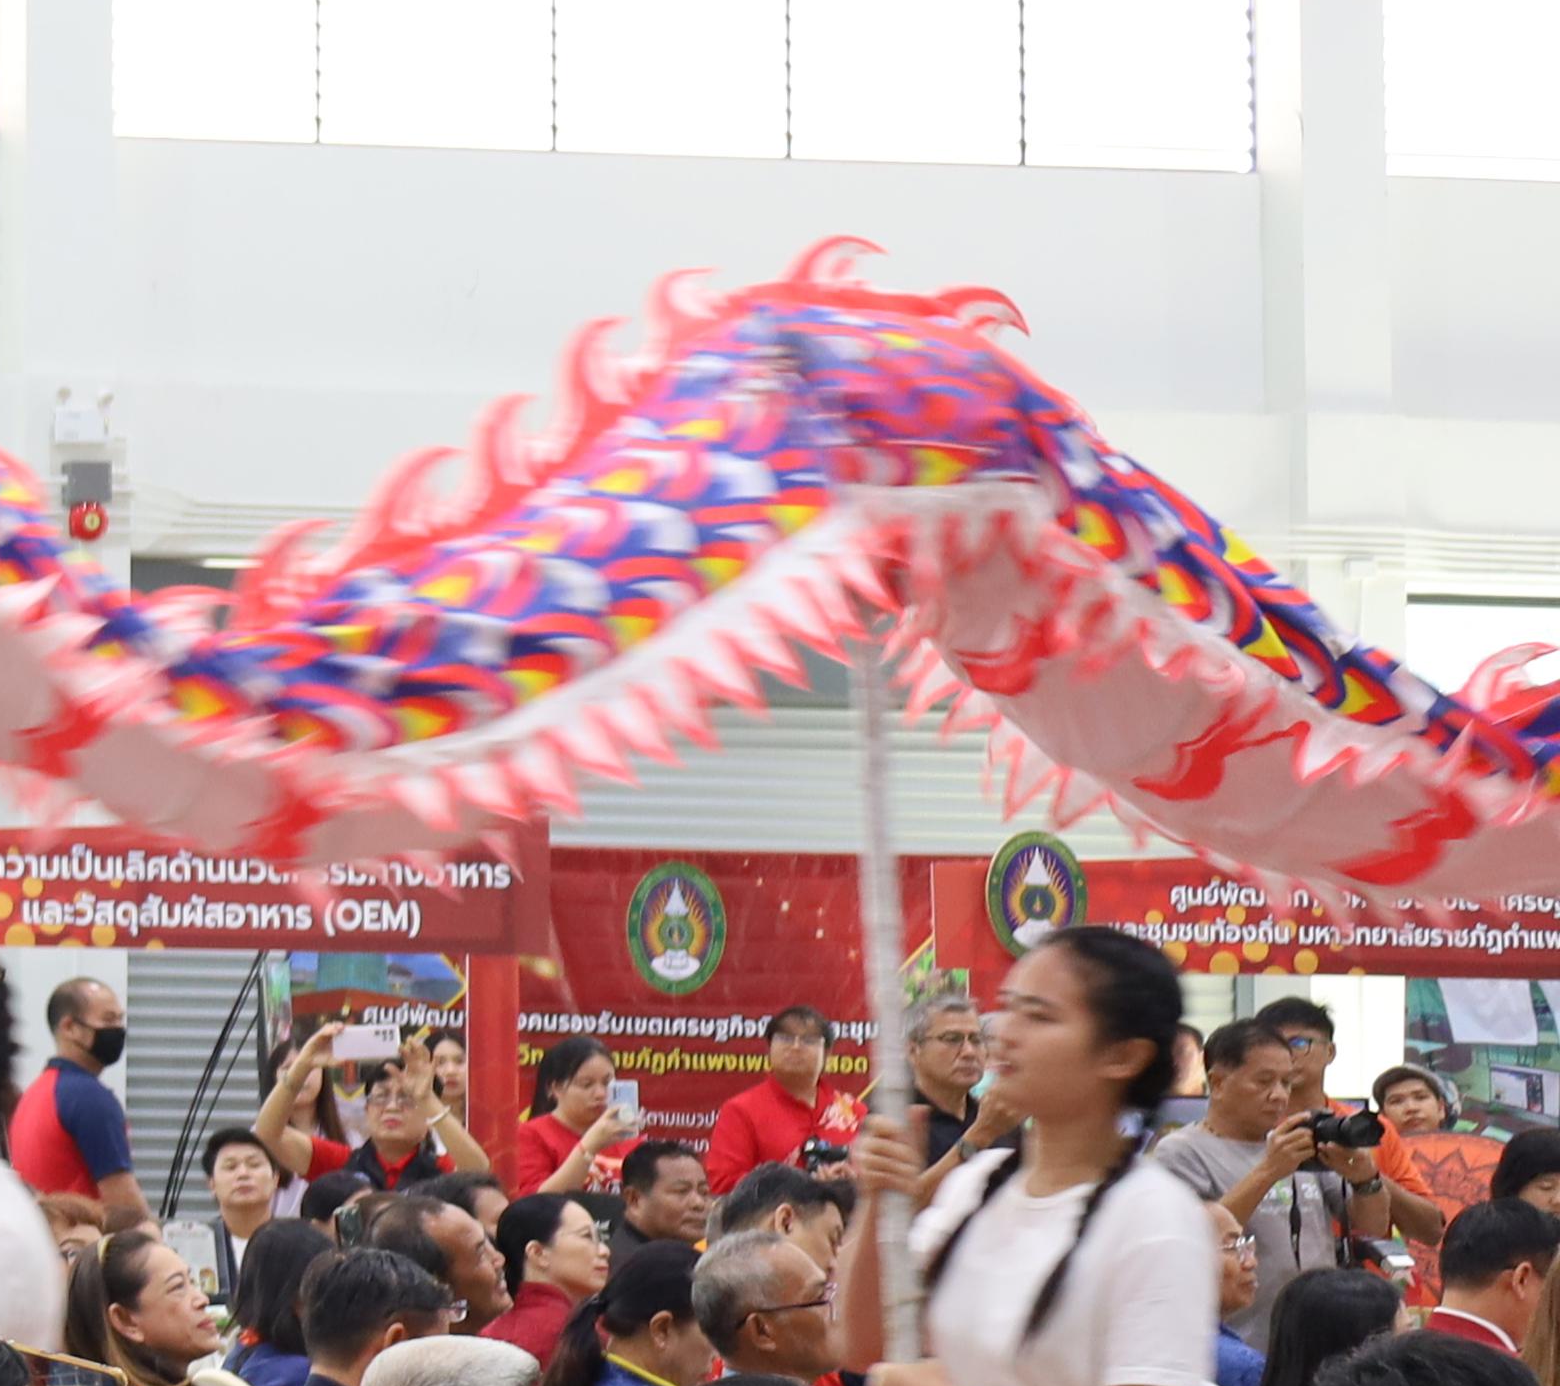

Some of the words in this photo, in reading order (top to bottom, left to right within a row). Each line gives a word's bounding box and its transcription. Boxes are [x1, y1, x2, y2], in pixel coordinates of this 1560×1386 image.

[22, 892, 312, 937] และวัสดุสัมผัสอาหาร
[324, 898, 422, 938] (OEM)
